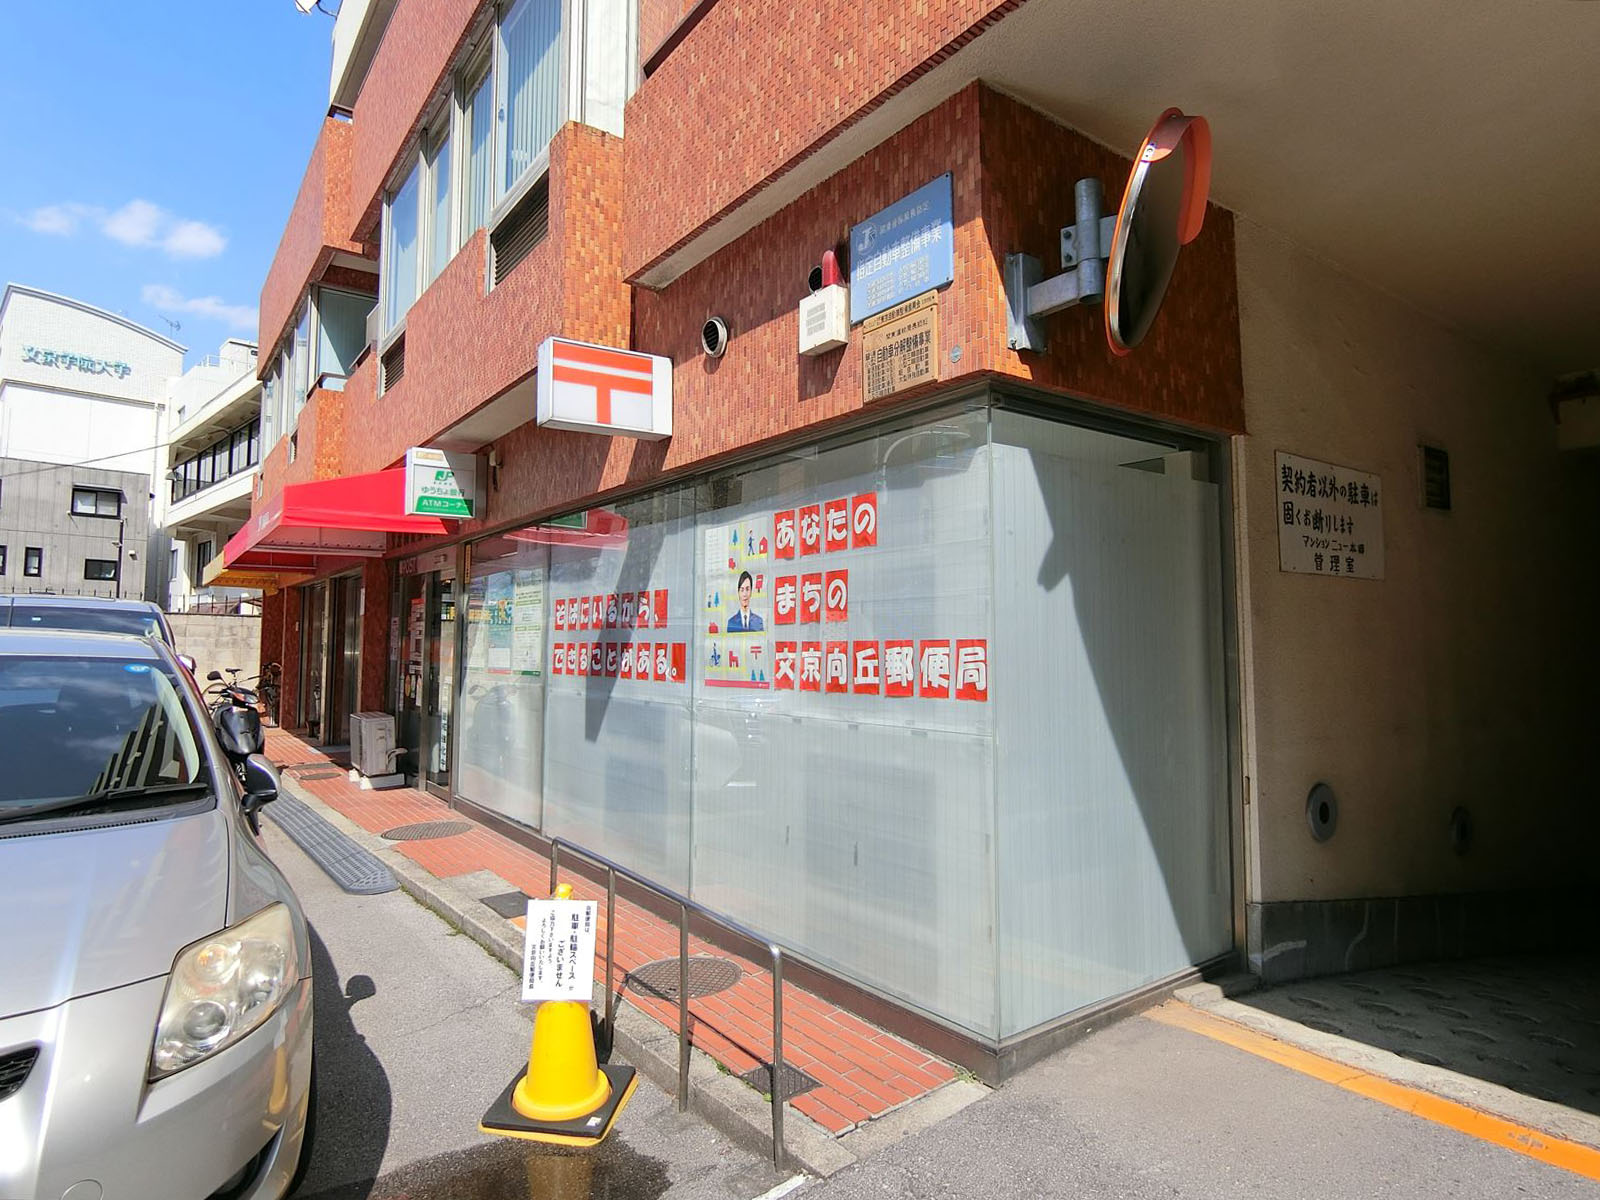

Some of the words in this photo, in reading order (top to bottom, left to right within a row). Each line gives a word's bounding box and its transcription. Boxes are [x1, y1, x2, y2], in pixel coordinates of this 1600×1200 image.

[22, 344, 132, 379] 文京学院大学
[877, 330, 931, 363] 自動車分解整備事業
[421, 485, 465, 497] ゆうちょ銀行
[1281, 463, 1378, 508] 契約者以外の駐車は
[775, 501, 877, 551] あなたの
[1282, 501, 1355, 536] 固くお断りします
[1314, 552, 1355, 573] 管理室
[555, 595, 661, 626] そばにいるから、
[775, 577, 848, 616] まちの
[553, 647, 678, 677] できることがある。
[775, 646, 986, 690] 文京向丘郵便局
[555, 939, 565, 988] ございません
